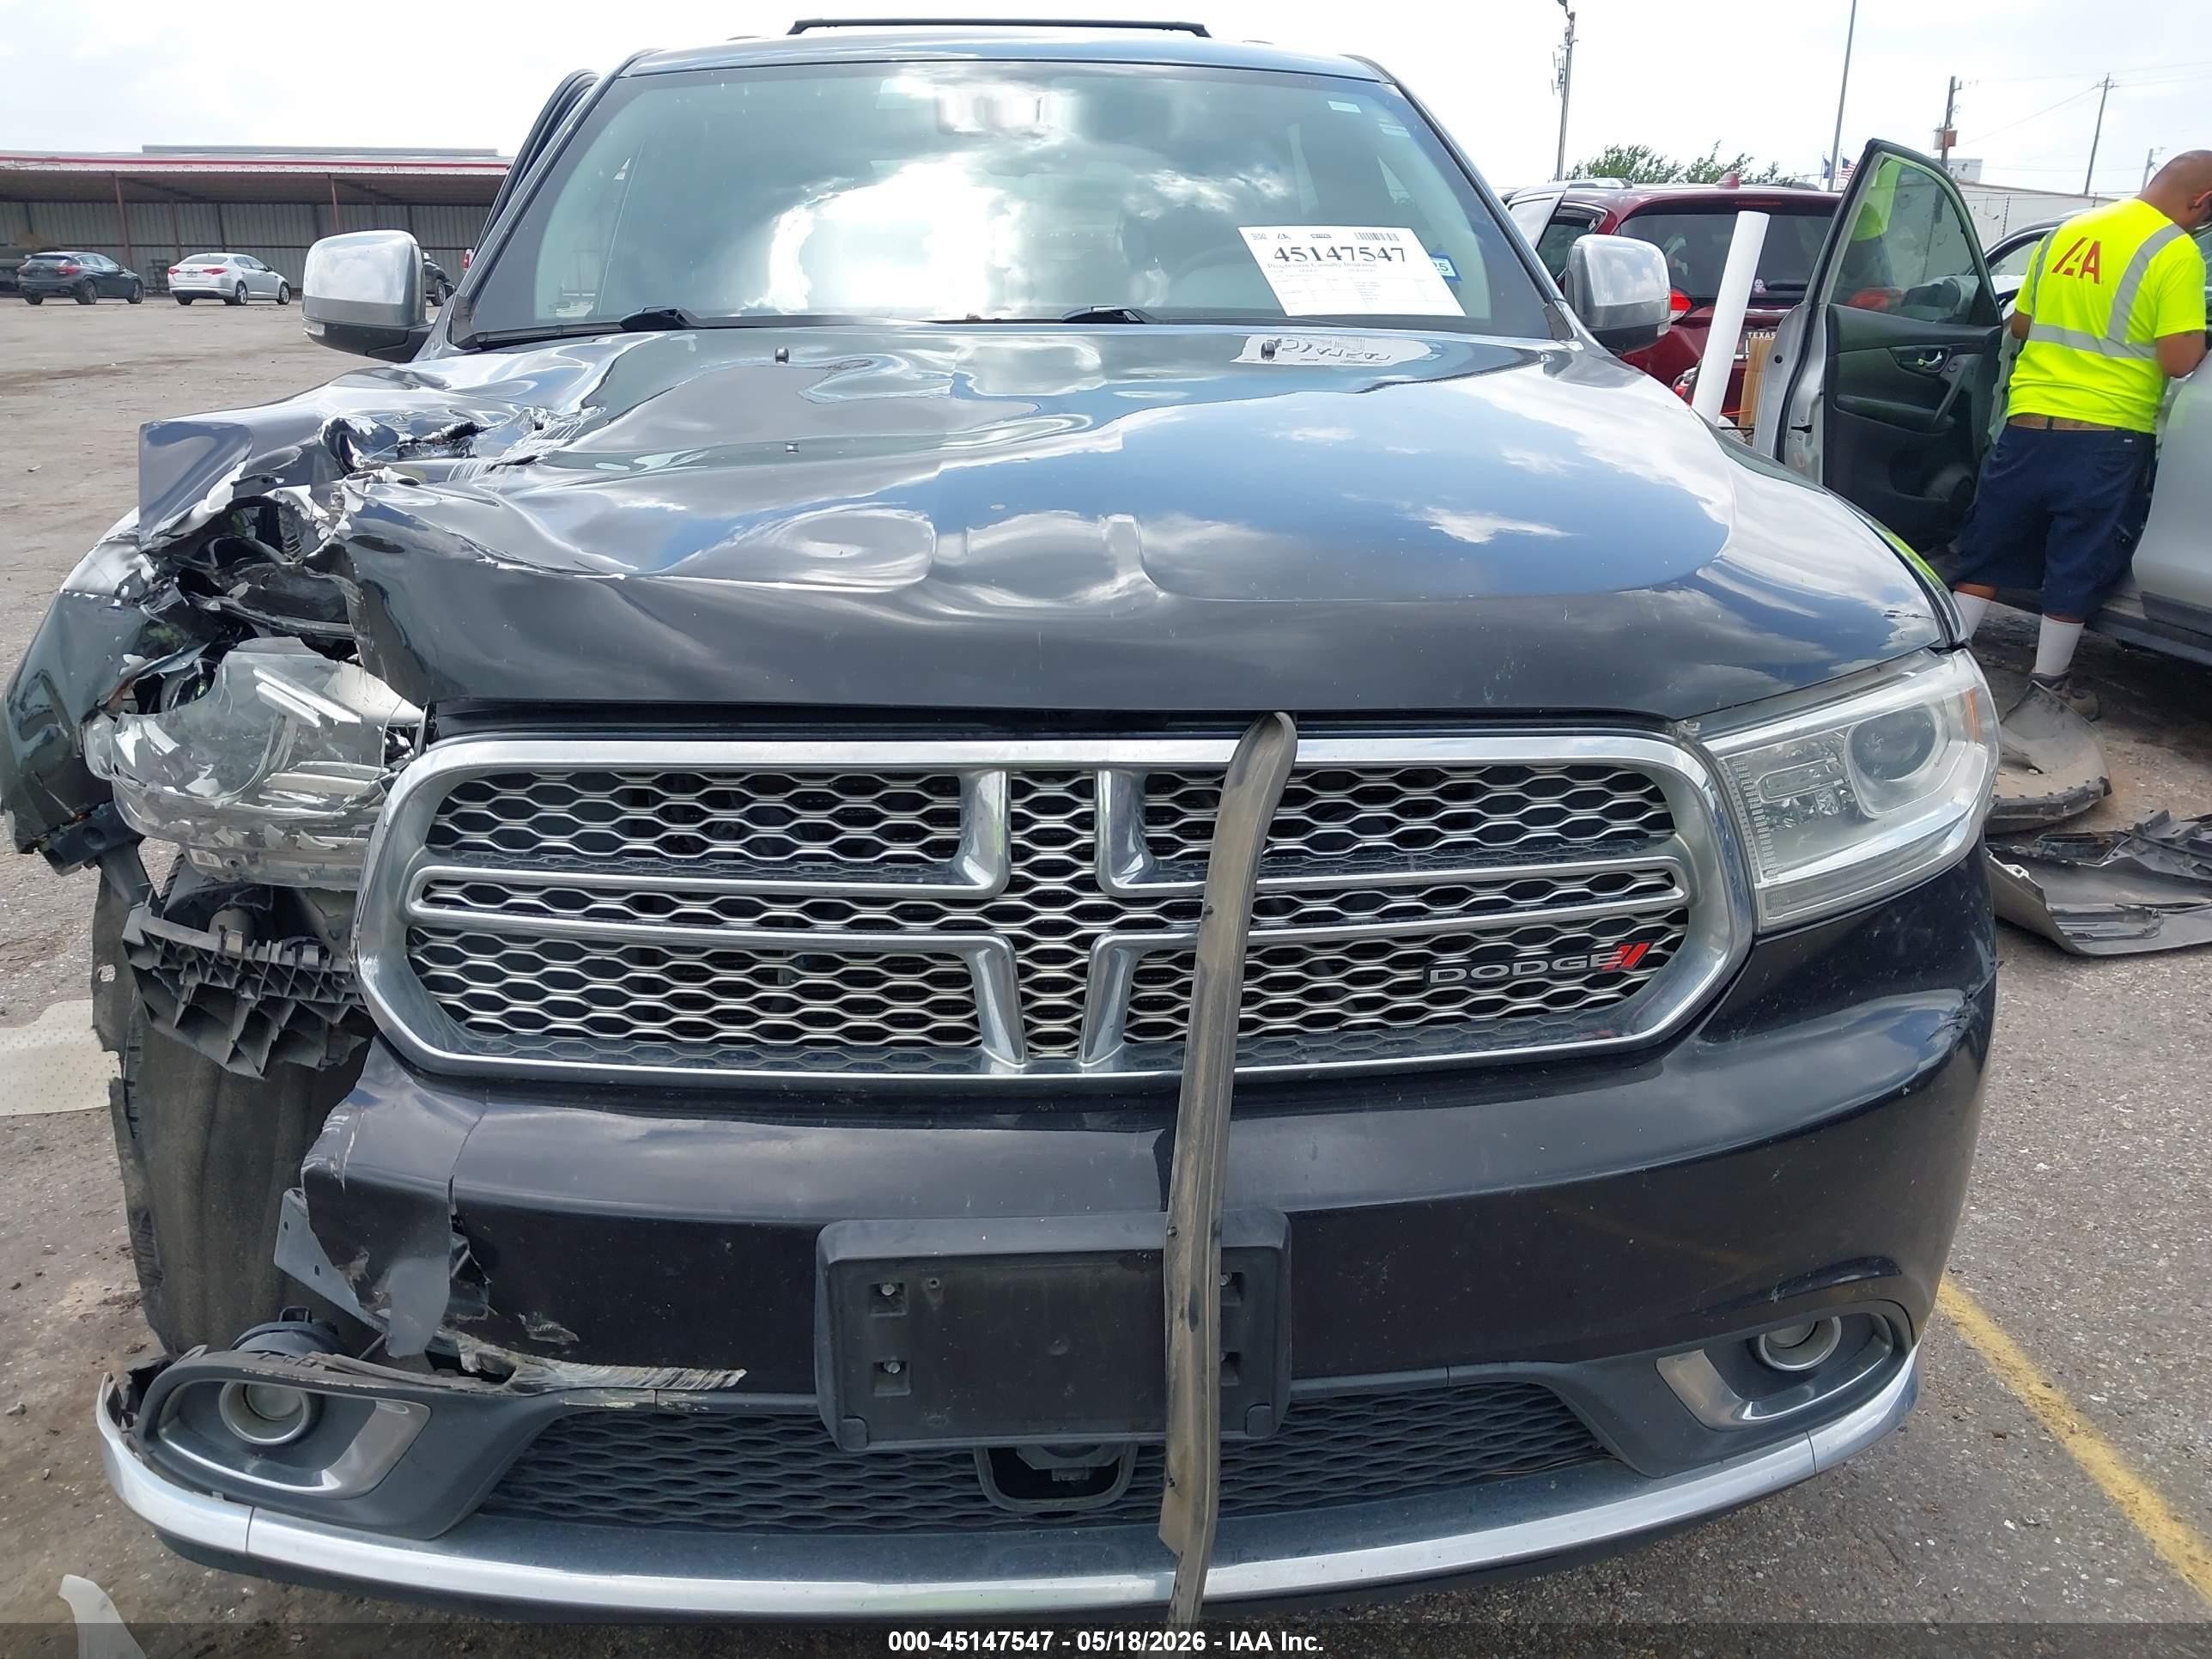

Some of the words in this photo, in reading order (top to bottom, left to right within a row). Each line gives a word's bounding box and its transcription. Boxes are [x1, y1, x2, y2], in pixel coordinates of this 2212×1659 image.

[1274, 246, 1406, 262] 45147547
[2052, 237, 2101, 285] IAA
[1429, 951, 1622, 983] DODGE
